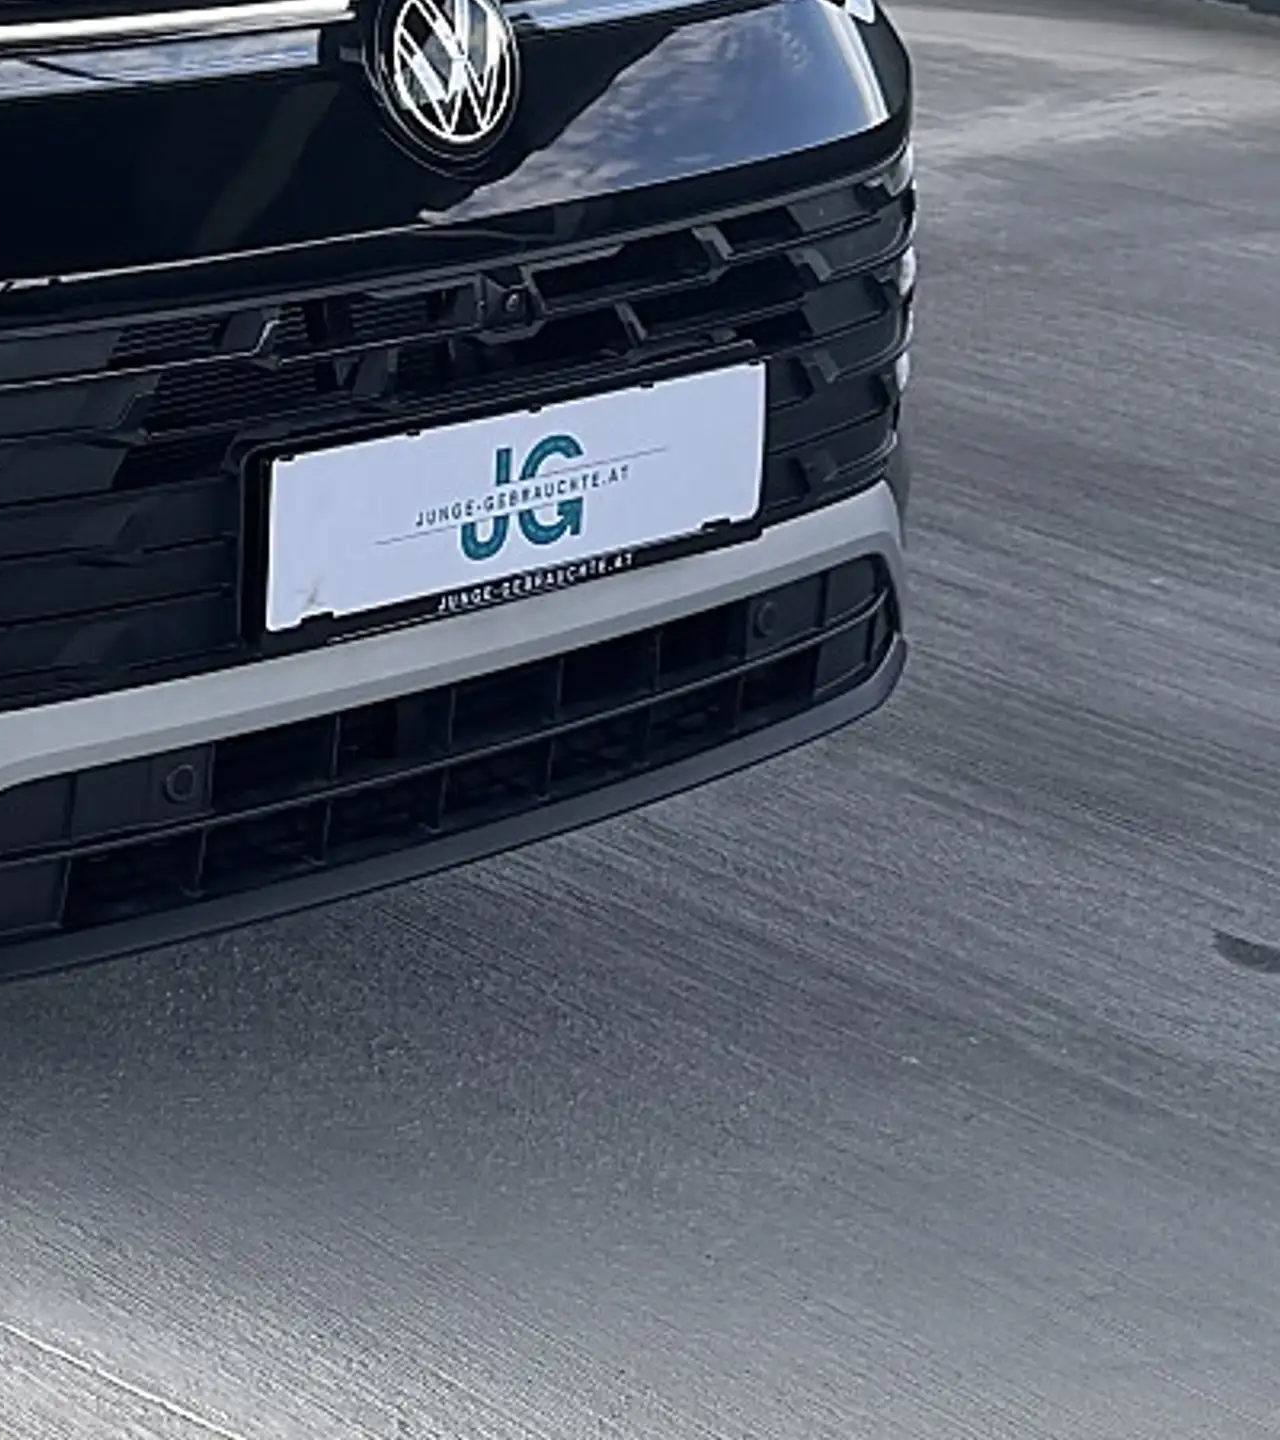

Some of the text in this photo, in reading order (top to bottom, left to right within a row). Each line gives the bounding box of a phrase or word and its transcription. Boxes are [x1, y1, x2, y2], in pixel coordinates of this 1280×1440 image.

[416, 464, 628, 527] JUNGE-GEBRAUCHTE.AT
[460, 434, 584, 561] JG
[437, 552, 634, 610] JUNGE-GEBRAUCHTE.AT
